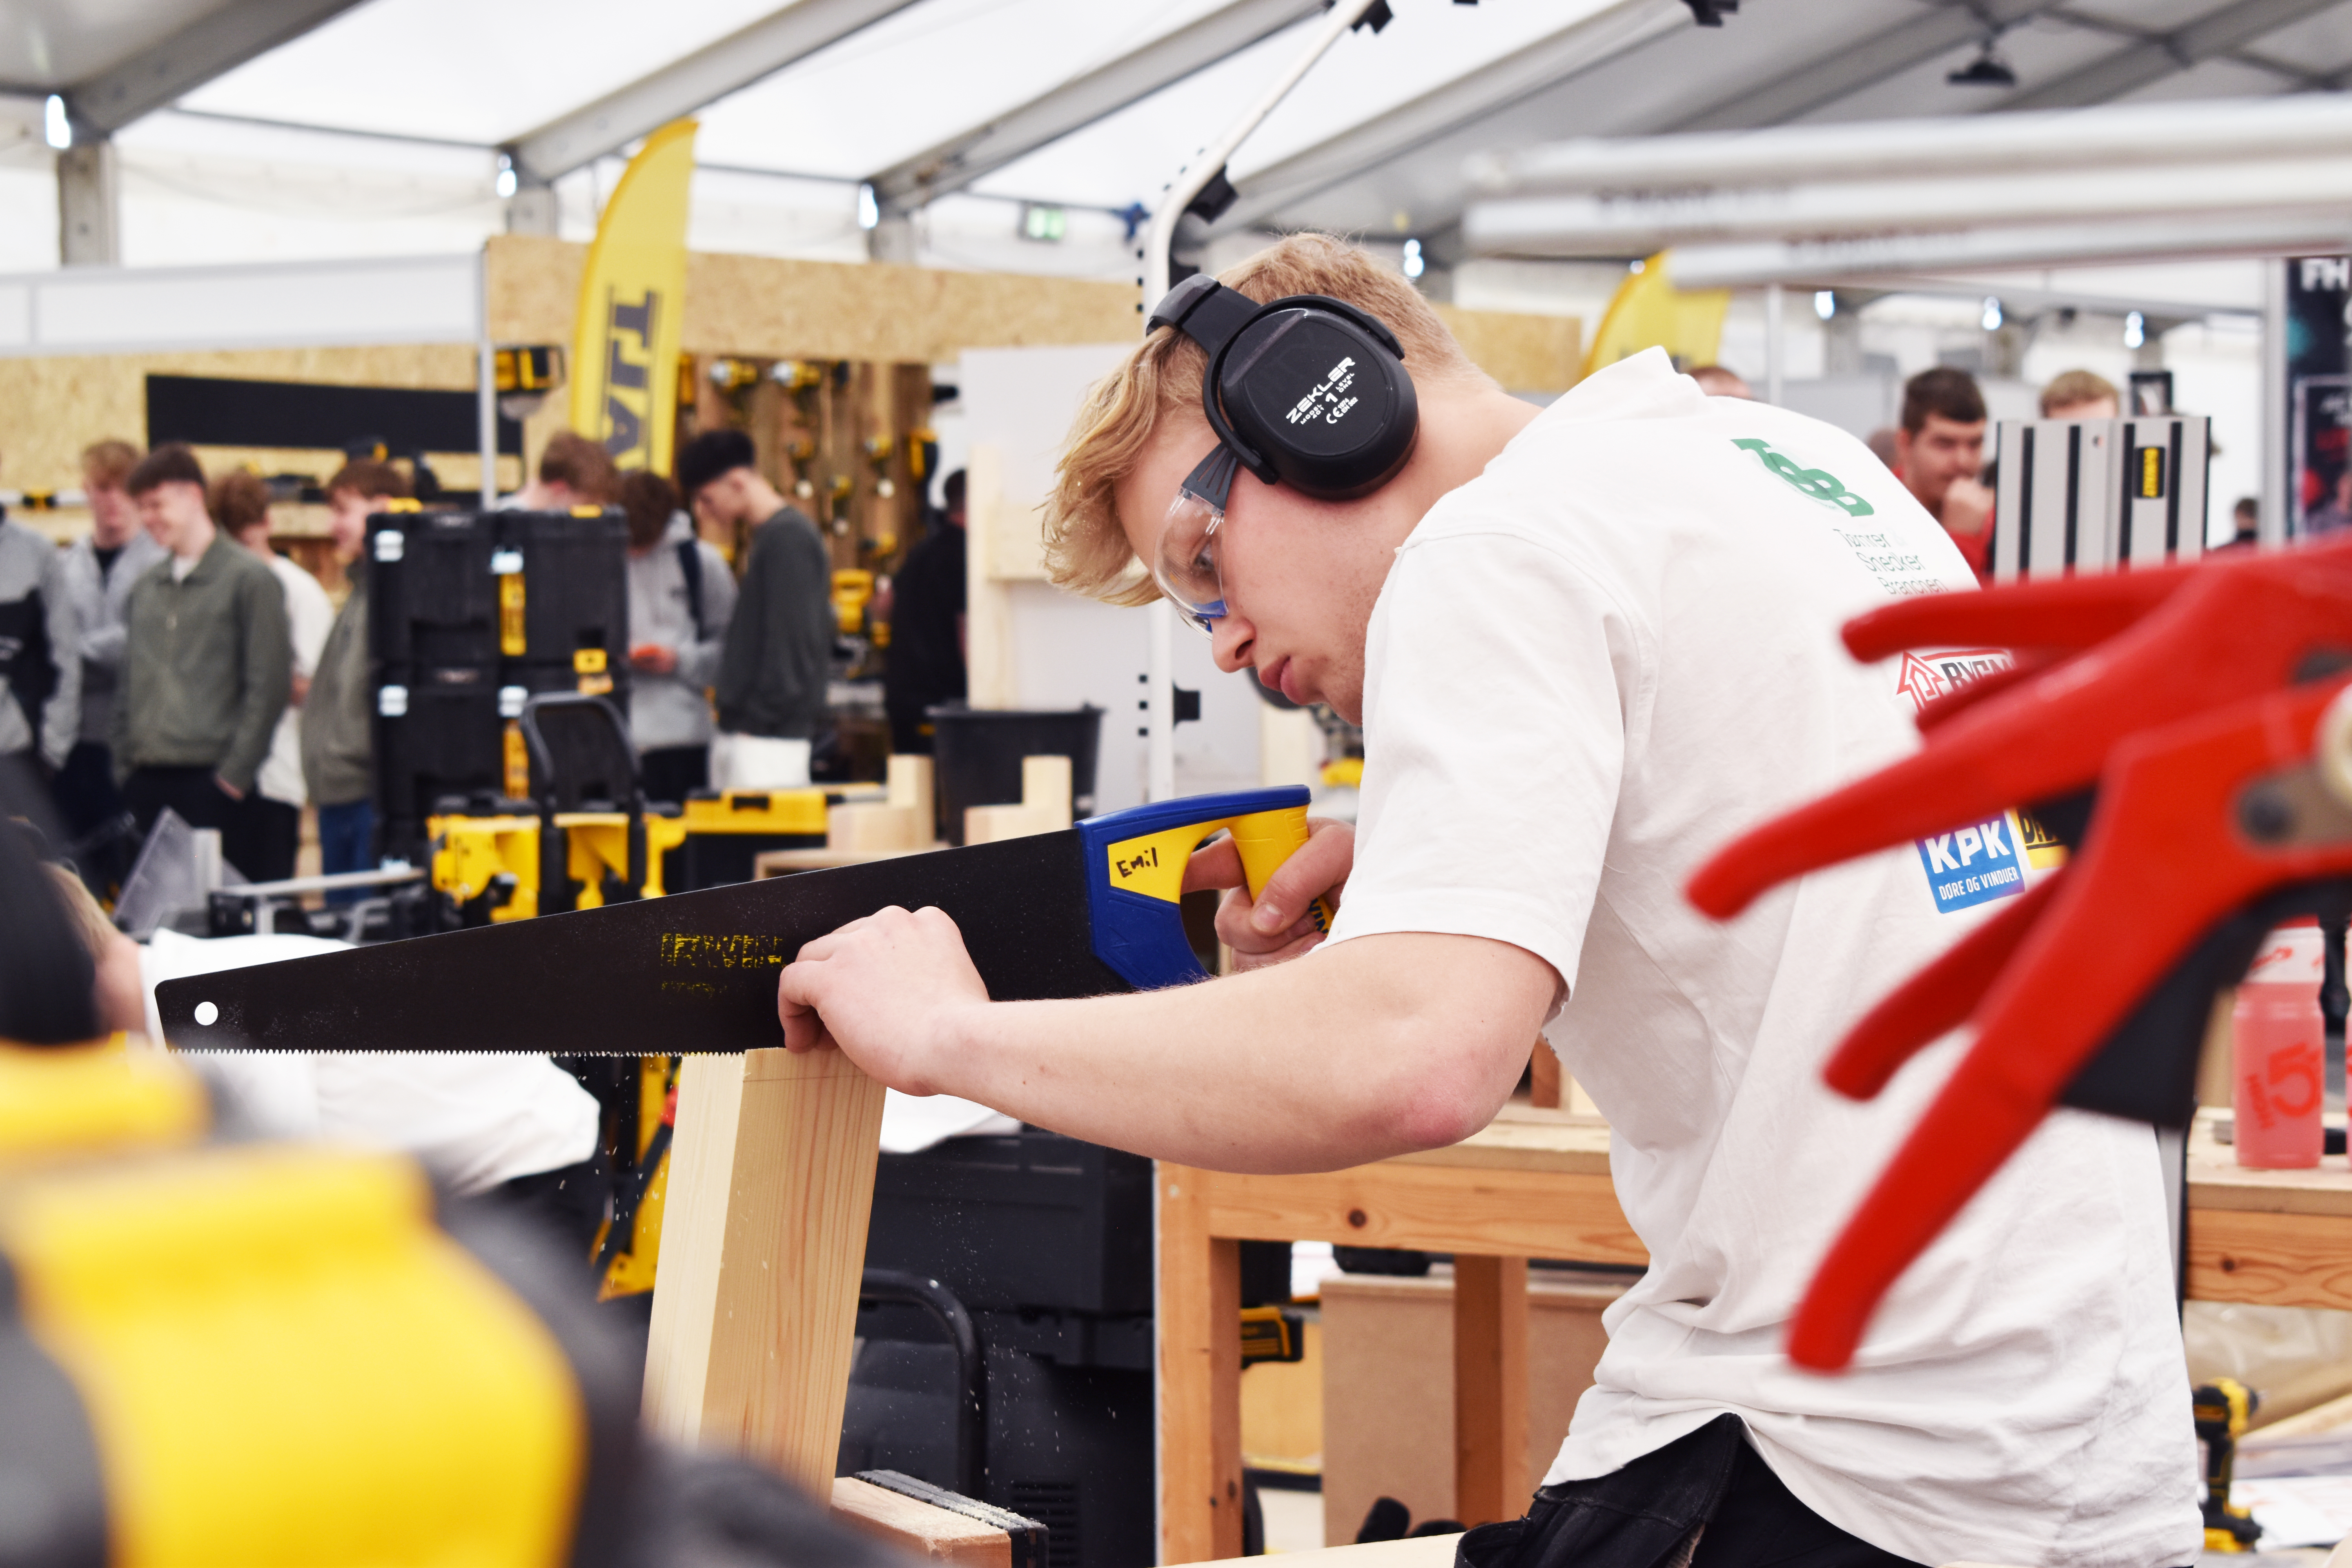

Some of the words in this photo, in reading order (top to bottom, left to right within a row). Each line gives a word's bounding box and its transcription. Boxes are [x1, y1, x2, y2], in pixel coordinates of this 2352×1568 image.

[1286, 356, 1356, 424] ZEKLER
[1335, 373, 1355, 390] LEVEL
[1338, 379, 1353, 393] ONE
[1325, 392, 1338, 403] 1
[1300, 405, 1322, 425] MODEL
[1312, 407, 1325, 419] 401
[1341, 404, 1350, 414] EN
[1856, 551, 1926, 572] Snedker
[1877, 576, 1949, 595] Branchen
[1925, 820, 2011, 874] KPK
[1116, 847, 1158, 878] Emil
[1938, 881, 1965, 900] DØRE
[1967, 877, 1980, 893] OG
[1980, 866, 2019, 889] VINDUER
